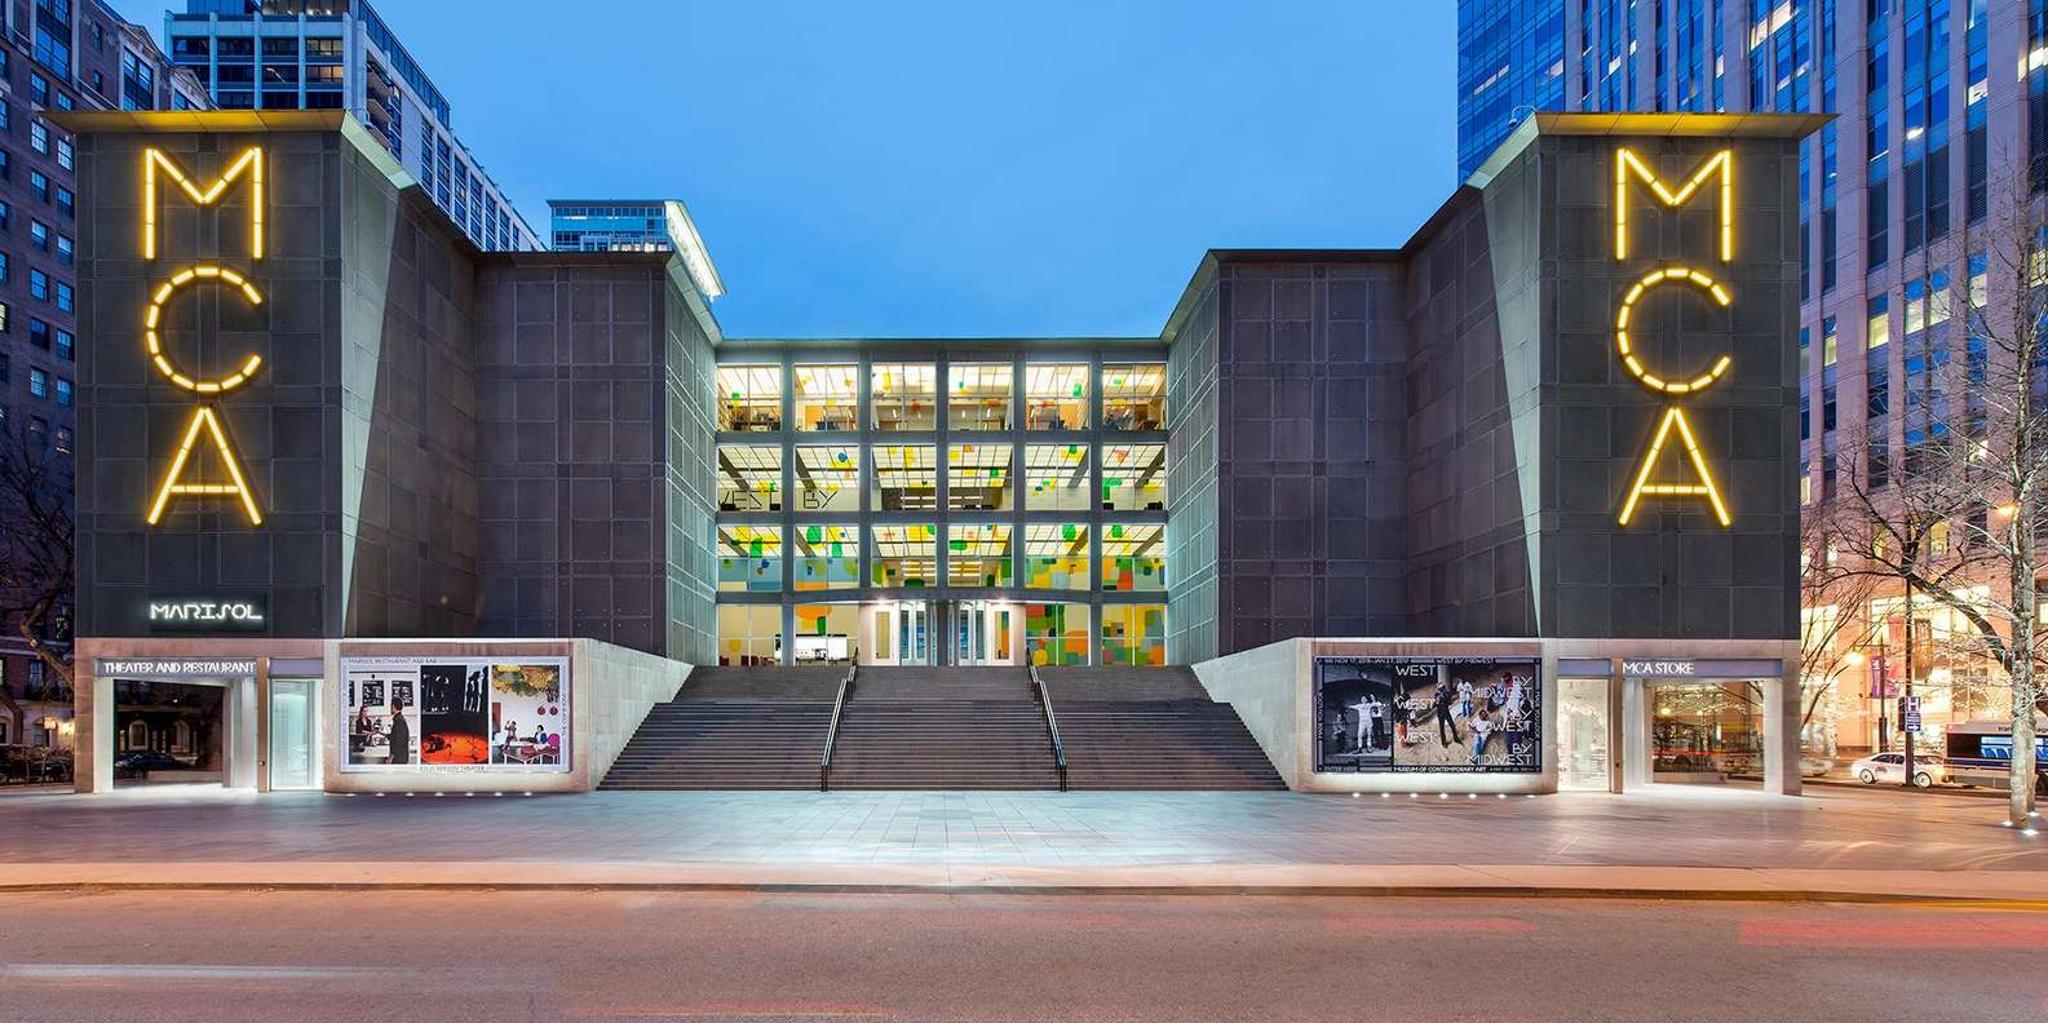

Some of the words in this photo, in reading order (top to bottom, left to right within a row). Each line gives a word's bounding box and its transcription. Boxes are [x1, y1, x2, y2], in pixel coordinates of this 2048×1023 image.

[143, 146, 264, 526] MCA
[1615, 147, 1734, 527] MCA
[150, 604, 263, 620] MARISOL
[104, 662, 154, 673] THEATER
[156, 662, 181, 673] AND
[183, 662, 257, 674] RESTAURANT
[1396, 666, 1436, 676] WEST
[1622, 662, 1653, 675] MCA
[1655, 662, 1695, 675] STORE
[1513, 743, 1532, 754] BY
[1467, 754, 1533, 765] MIDWEST
